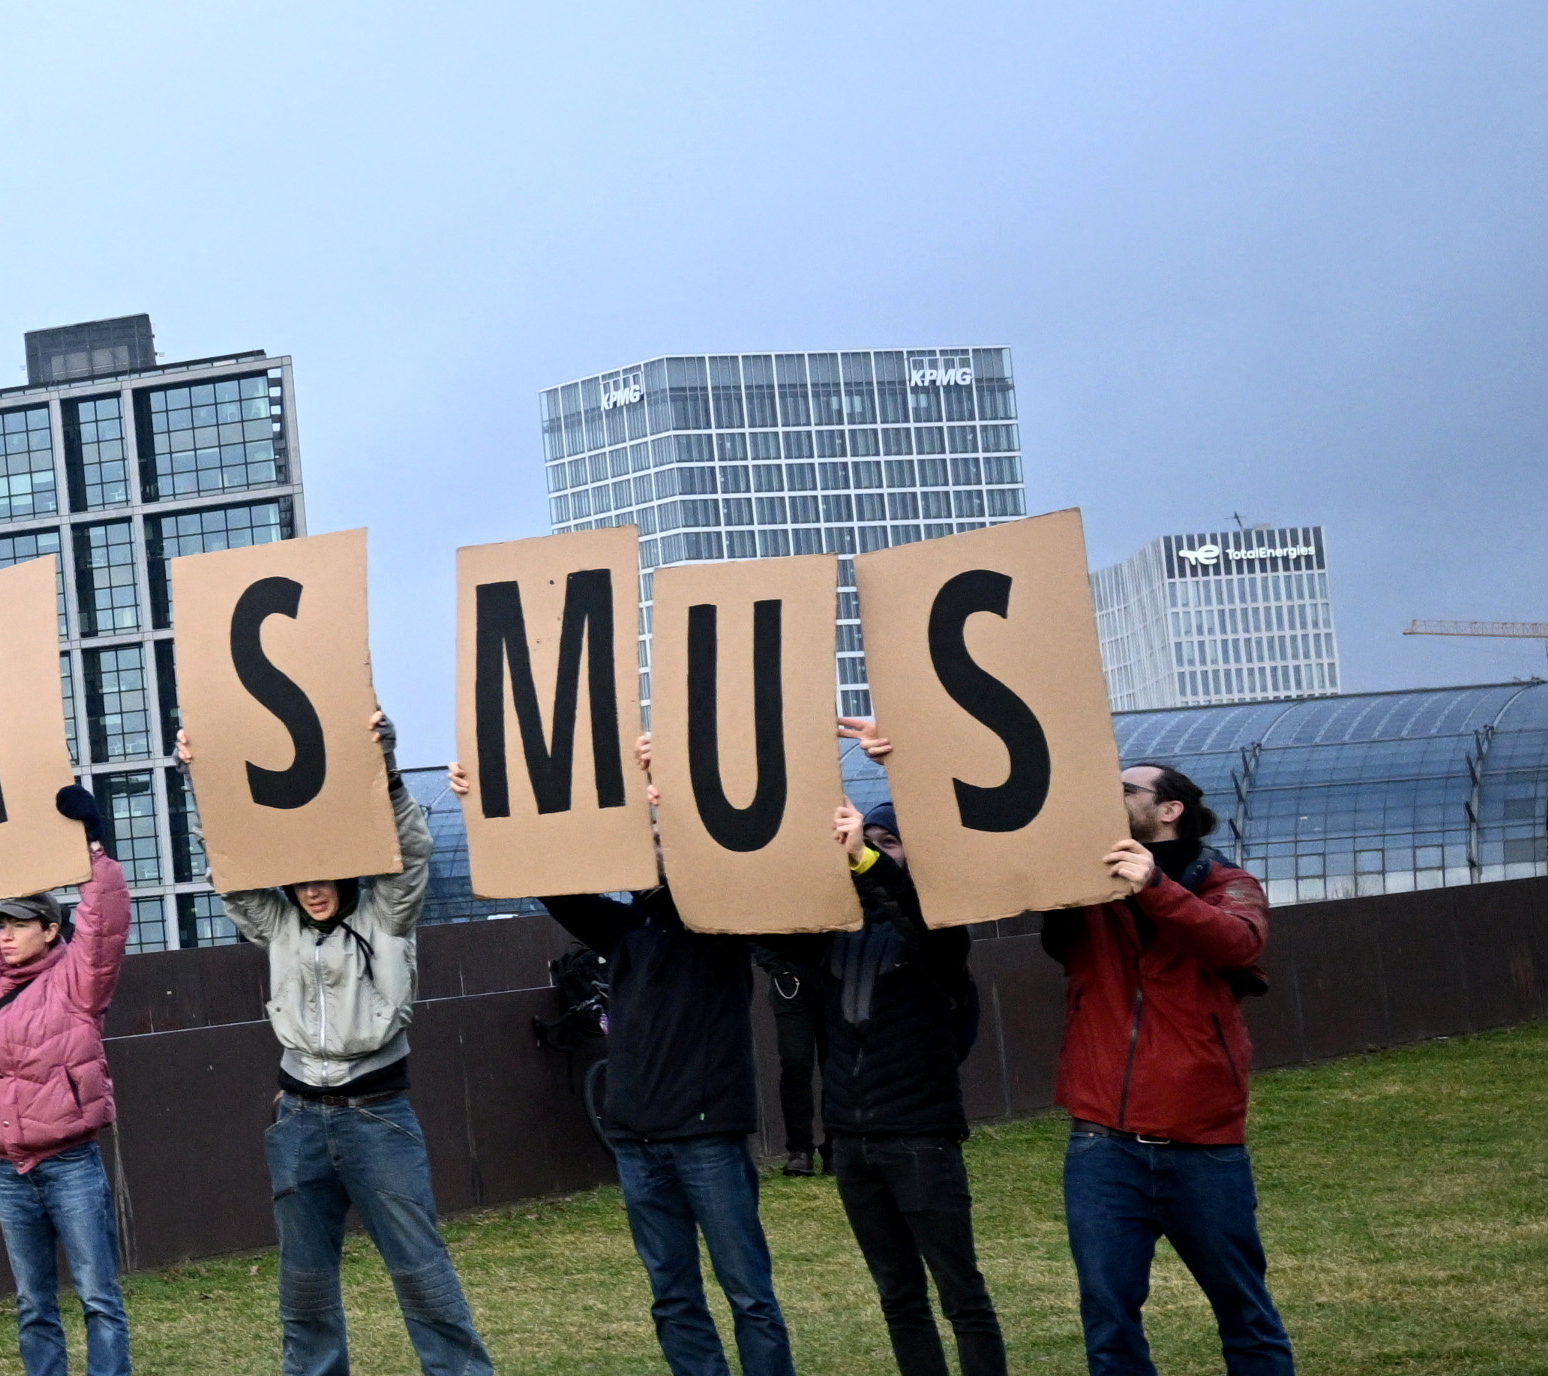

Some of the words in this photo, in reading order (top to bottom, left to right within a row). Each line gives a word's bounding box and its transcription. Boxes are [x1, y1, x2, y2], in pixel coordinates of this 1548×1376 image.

[911, 367, 971, 386] KPMG
[601, 384, 640, 411] KPMG
[1226, 544, 1315, 560] TotalEnergies
